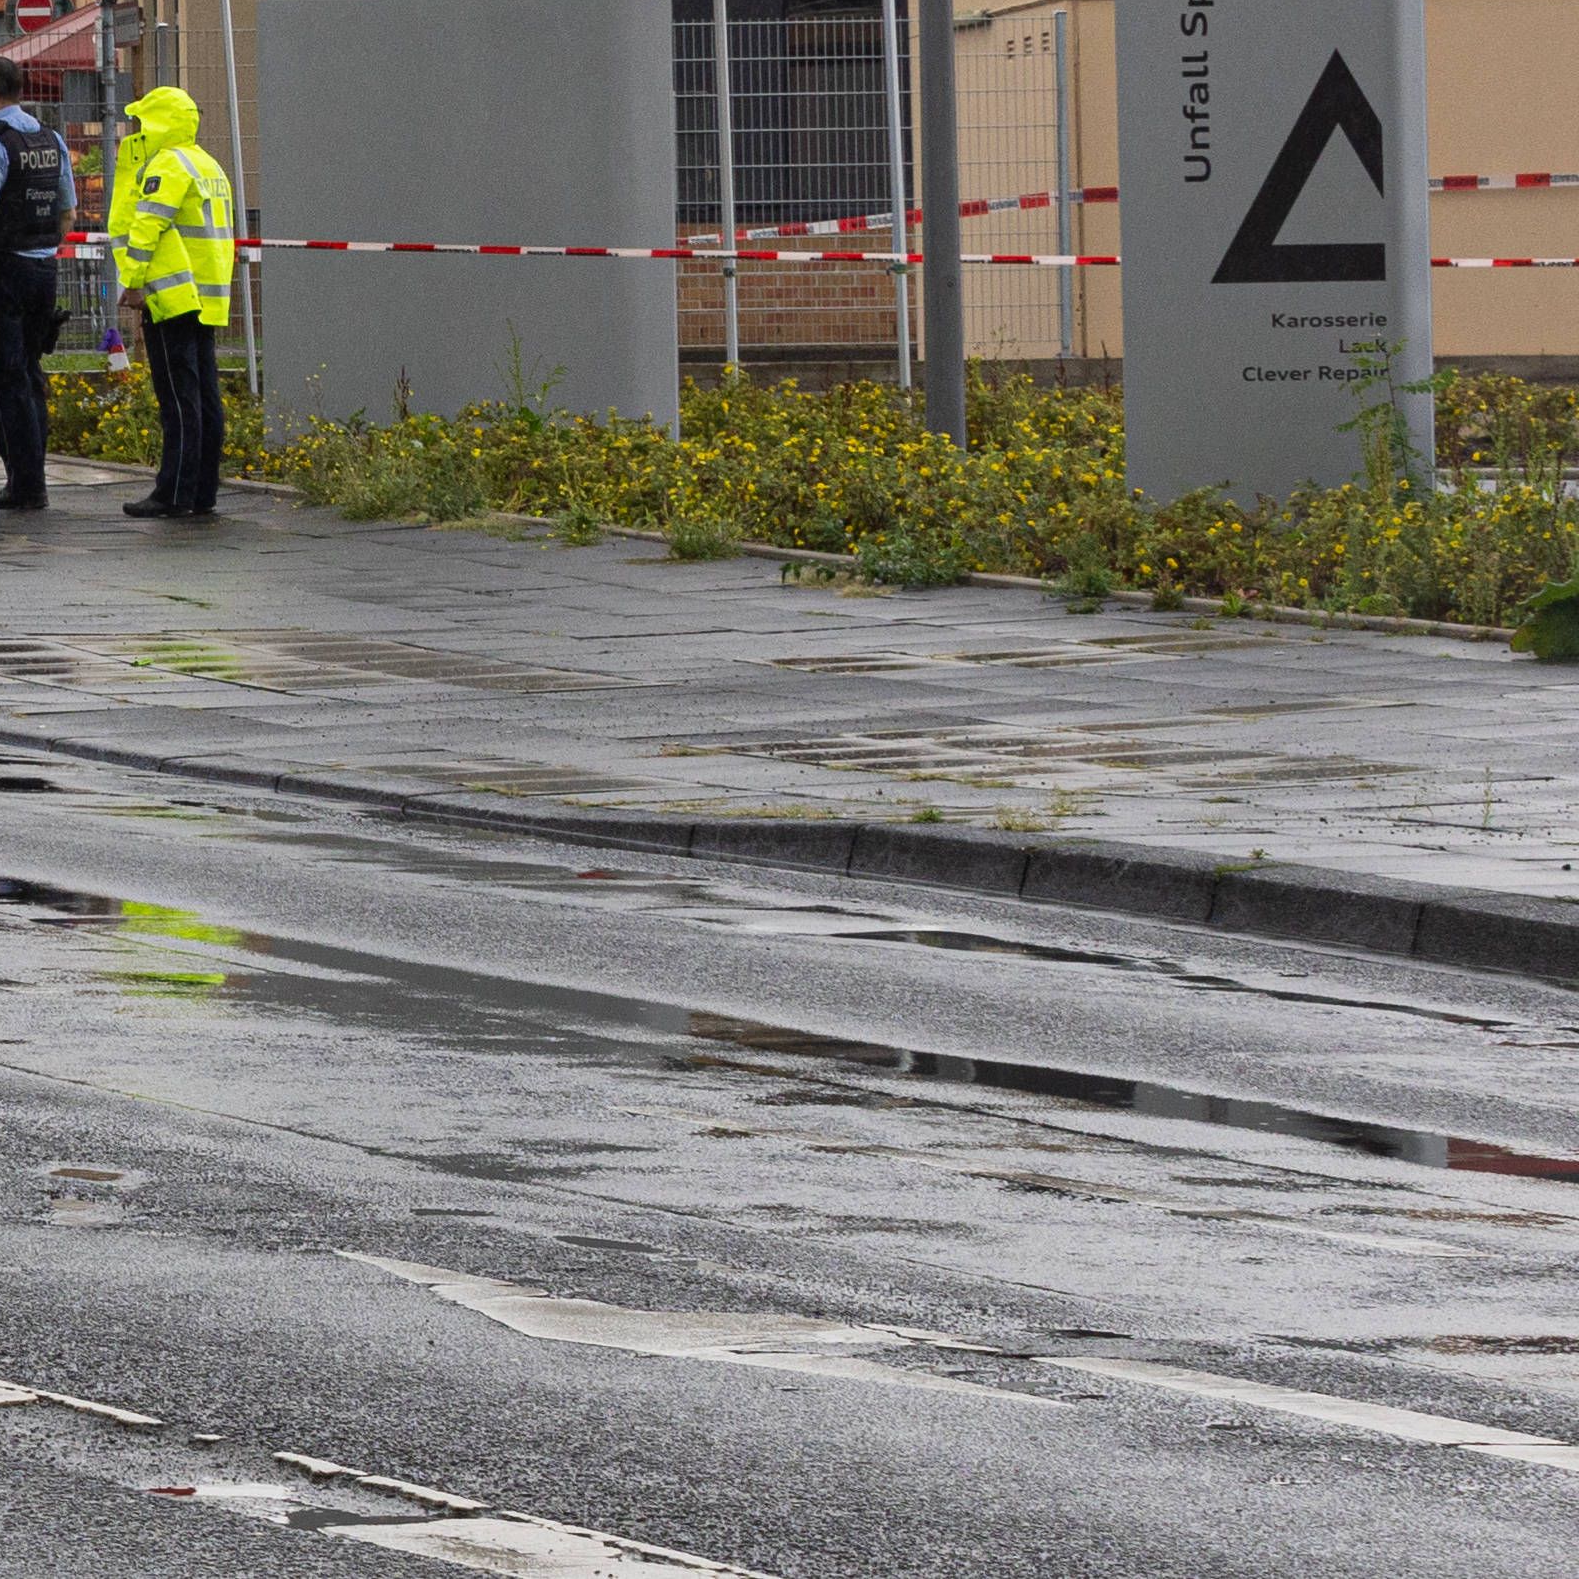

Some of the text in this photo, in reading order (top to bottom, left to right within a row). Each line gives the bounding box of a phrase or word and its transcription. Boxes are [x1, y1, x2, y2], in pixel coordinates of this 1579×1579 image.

[1182, 50, 1212, 184] Unfall
[20, 148, 59, 170] POLIZEI
[1272, 312, 1388, 328] Karosserie
[1243, 365, 1389, 383] Clever Repair
